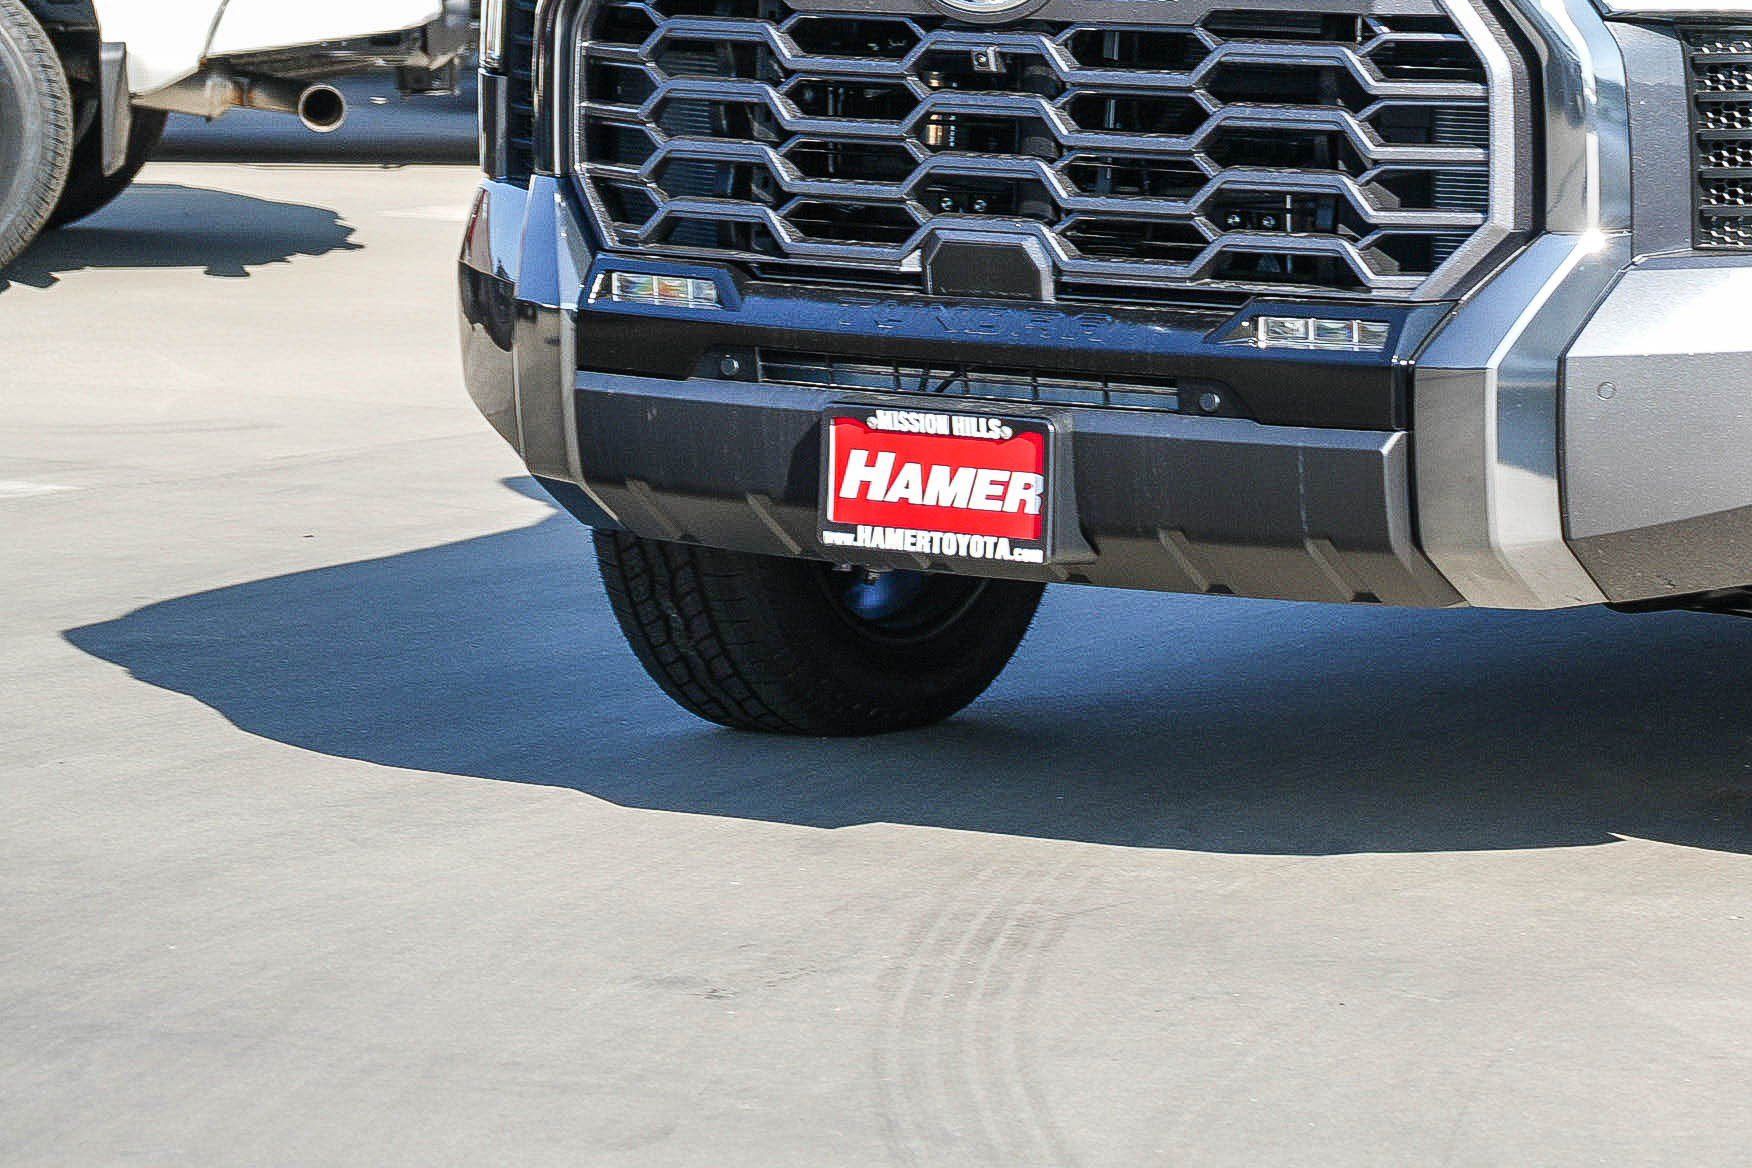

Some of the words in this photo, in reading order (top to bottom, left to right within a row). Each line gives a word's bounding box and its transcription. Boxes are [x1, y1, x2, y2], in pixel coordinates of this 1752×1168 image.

[875, 409, 950, 436] MISSION
[951, 414, 1002, 439] HILLS
[838, 448, 1045, 516] HAMER
